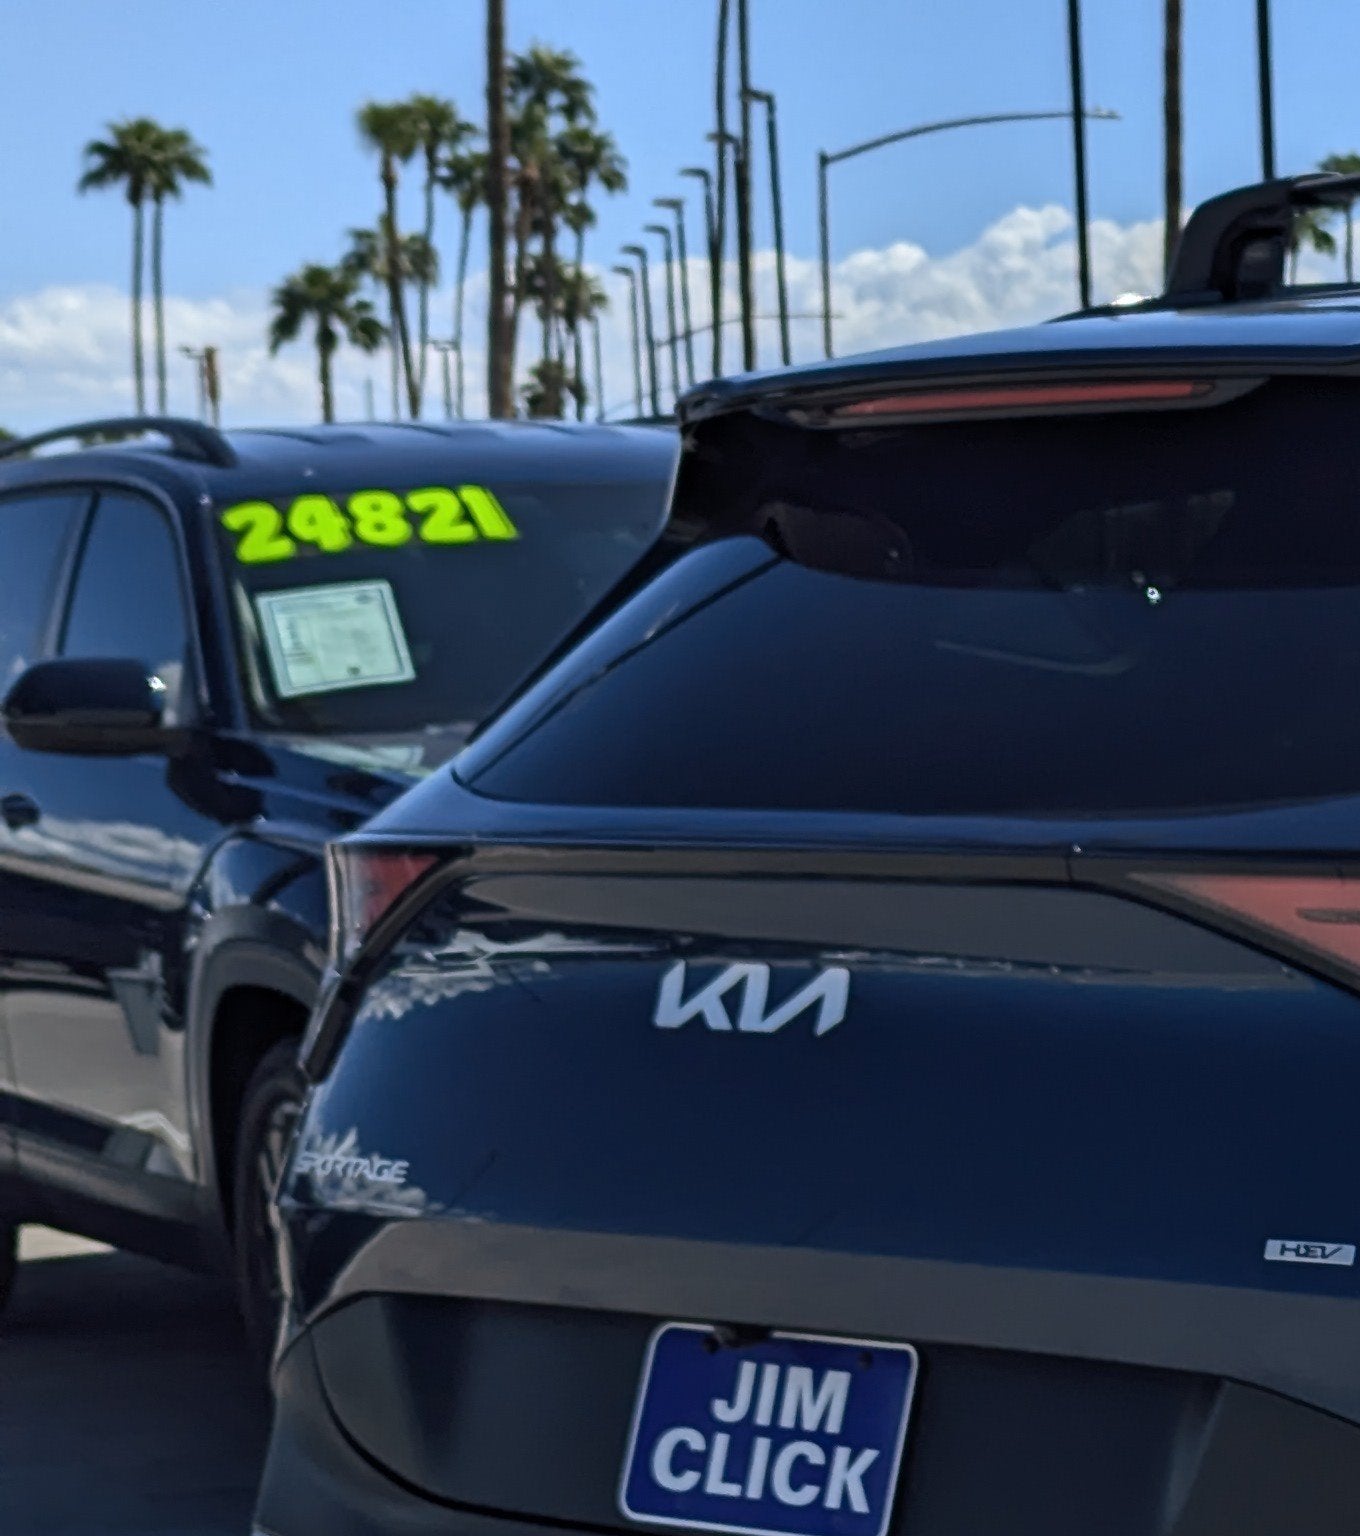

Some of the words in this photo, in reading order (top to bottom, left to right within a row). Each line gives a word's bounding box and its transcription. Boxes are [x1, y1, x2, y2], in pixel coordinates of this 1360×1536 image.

[219, 485, 519, 563] 24821
[653, 960, 850, 1036] KIA
[1279, 1243, 1343, 1260] HEV
[710, 1360, 852, 1434] JIM
[650, 1426, 880, 1514] CLICK
